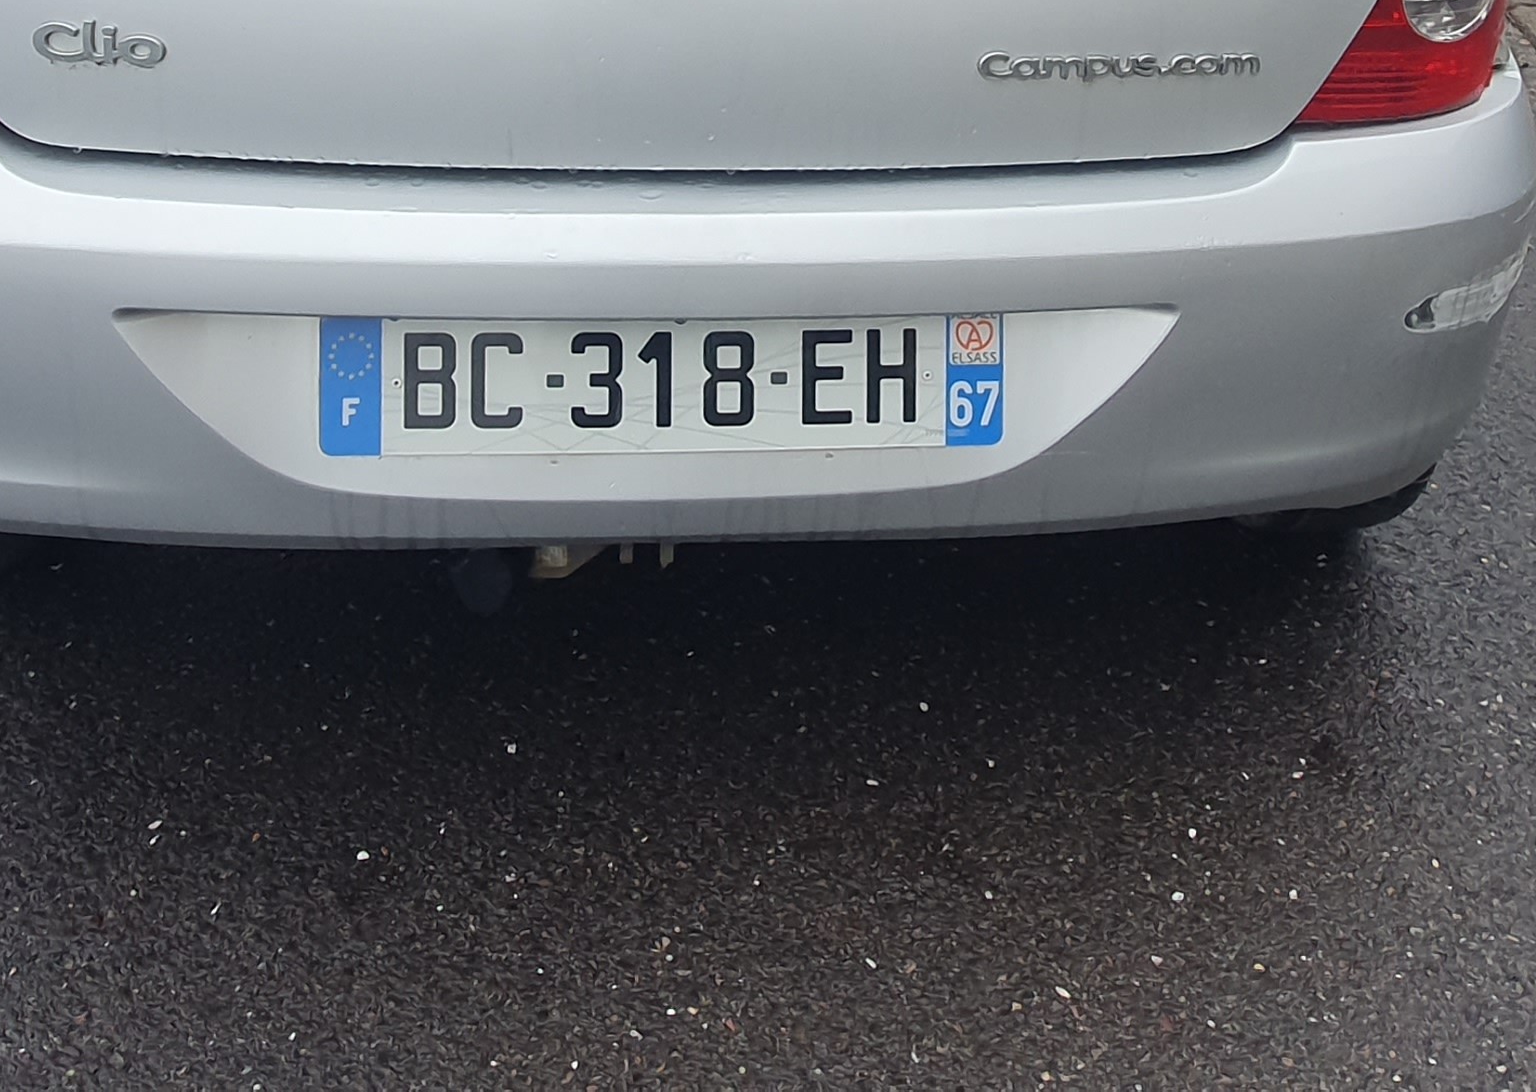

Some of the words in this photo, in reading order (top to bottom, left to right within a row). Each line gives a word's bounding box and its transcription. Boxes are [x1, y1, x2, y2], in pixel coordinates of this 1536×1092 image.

[32, 19, 167, 69] Clio
[977, 51, 1261, 82] Campus.com
[951, 351, 998, 364] ELSASS
[402, 328, 918, 430] BC-318-EH
[341, 397, 361, 427] F
[949, 380, 1000, 428] 67
